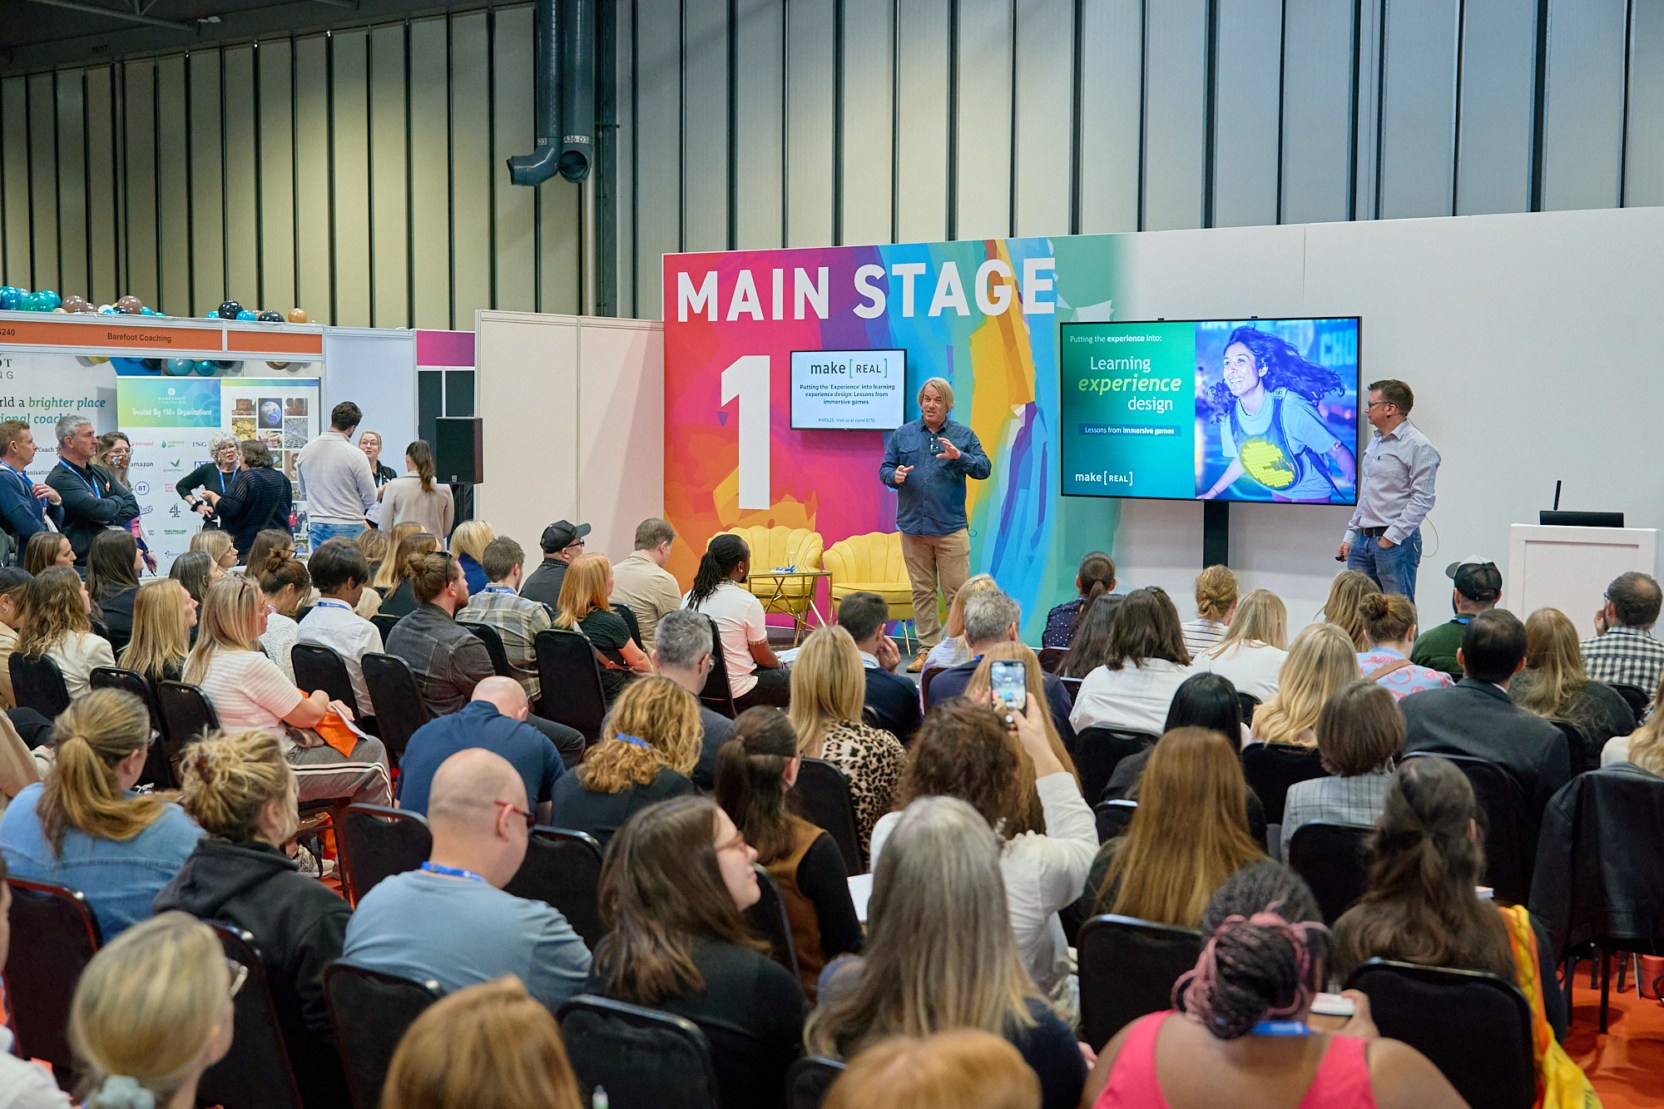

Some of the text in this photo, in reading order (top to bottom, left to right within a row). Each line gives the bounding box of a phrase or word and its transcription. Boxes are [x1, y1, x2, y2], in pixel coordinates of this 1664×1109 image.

[677, 257, 1056, 322] MAIN STAGE
[107, 332, 172, 343] Barefoot Coaching
[1070, 335, 1093, 344] Putting
[1107, 334, 1145, 343] experience
[1146, 334, 1162, 342] into:
[811, 361, 846, 375] make
[1090, 355, 1151, 373] Learning
[800, 383, 819, 391] Putting
[873, 383, 895, 391] learning
[1078, 373, 1182, 396] experience
[18, 400, 25, 408] a
[28, 396, 74, 411] brighter
[77, 396, 106, 410] place
[1127, 395, 1173, 414] design
[721, 355, 770, 510] 1
[1084, 426, 1107, 434] Lessons
[1107, 426, 1122, 434] from
[1154, 427, 1175, 435] games
[1075, 471, 1102, 482] make
